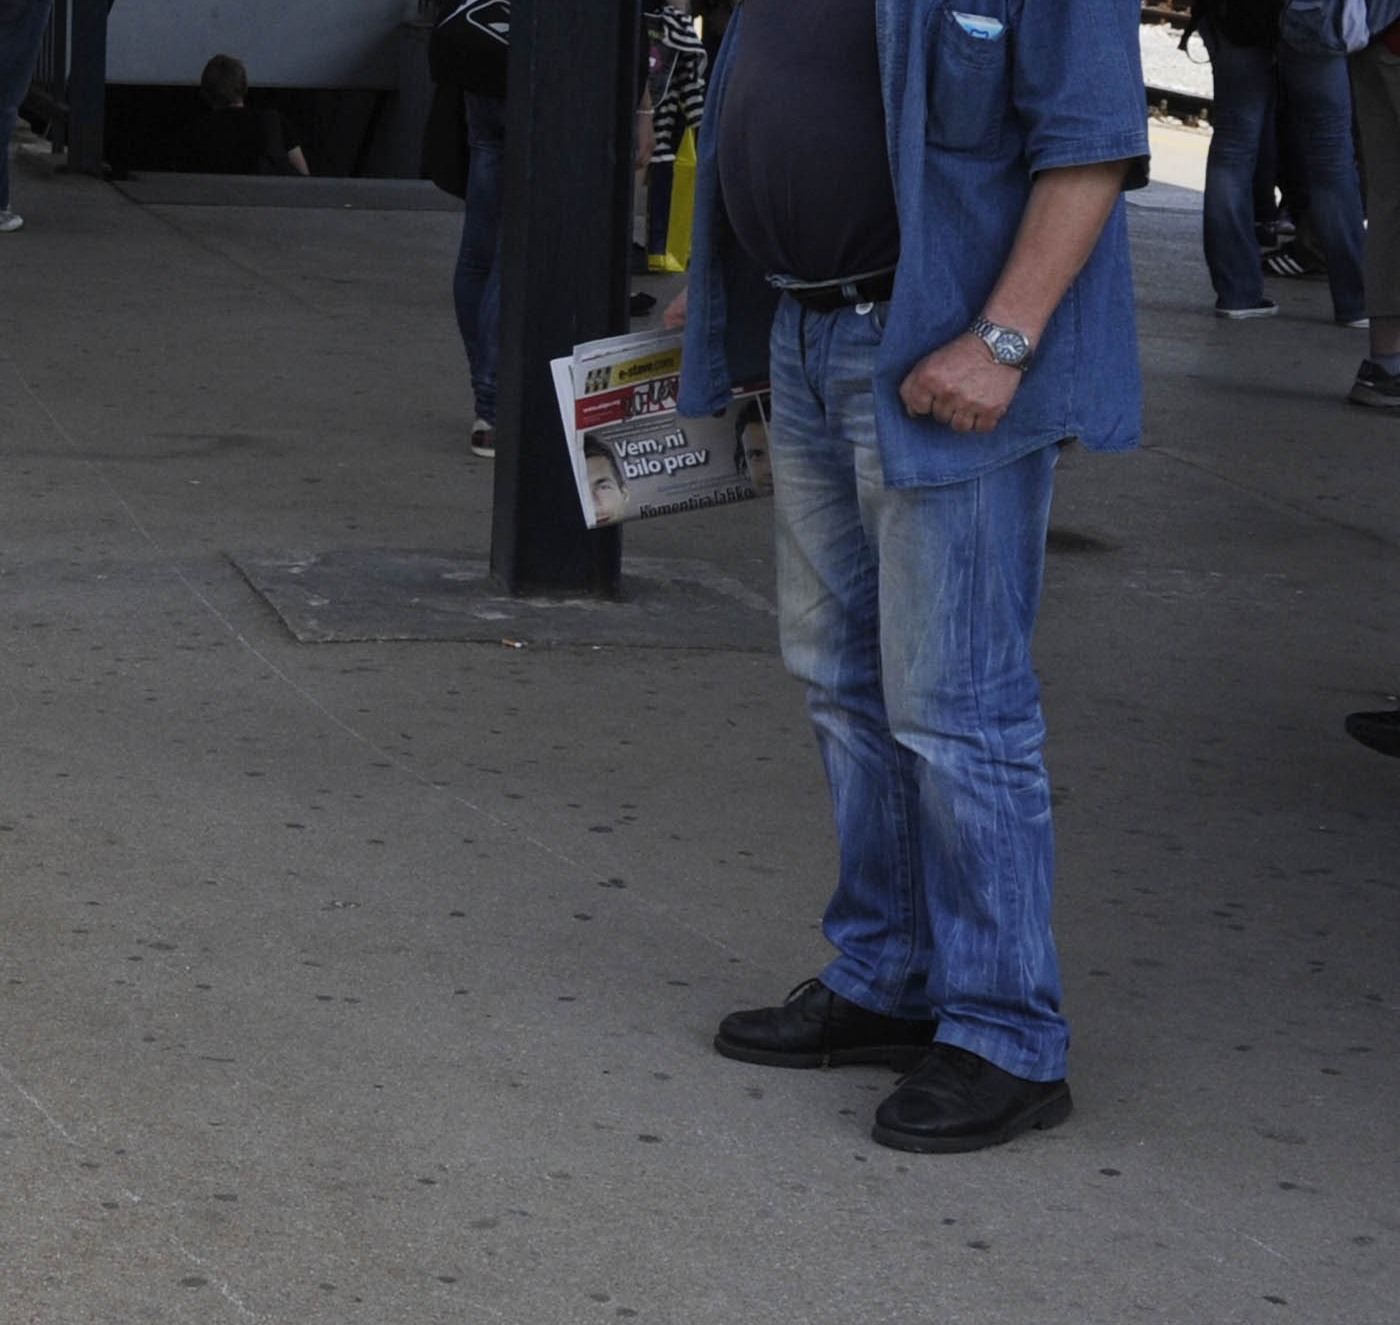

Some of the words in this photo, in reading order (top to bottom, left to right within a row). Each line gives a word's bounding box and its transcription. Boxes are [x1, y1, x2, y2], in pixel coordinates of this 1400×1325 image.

[614, 437, 663, 458] Vem,
[665, 429, 686, 449] ni
[623, 457, 662, 478] bilo
[664, 449, 708, 474] prav
